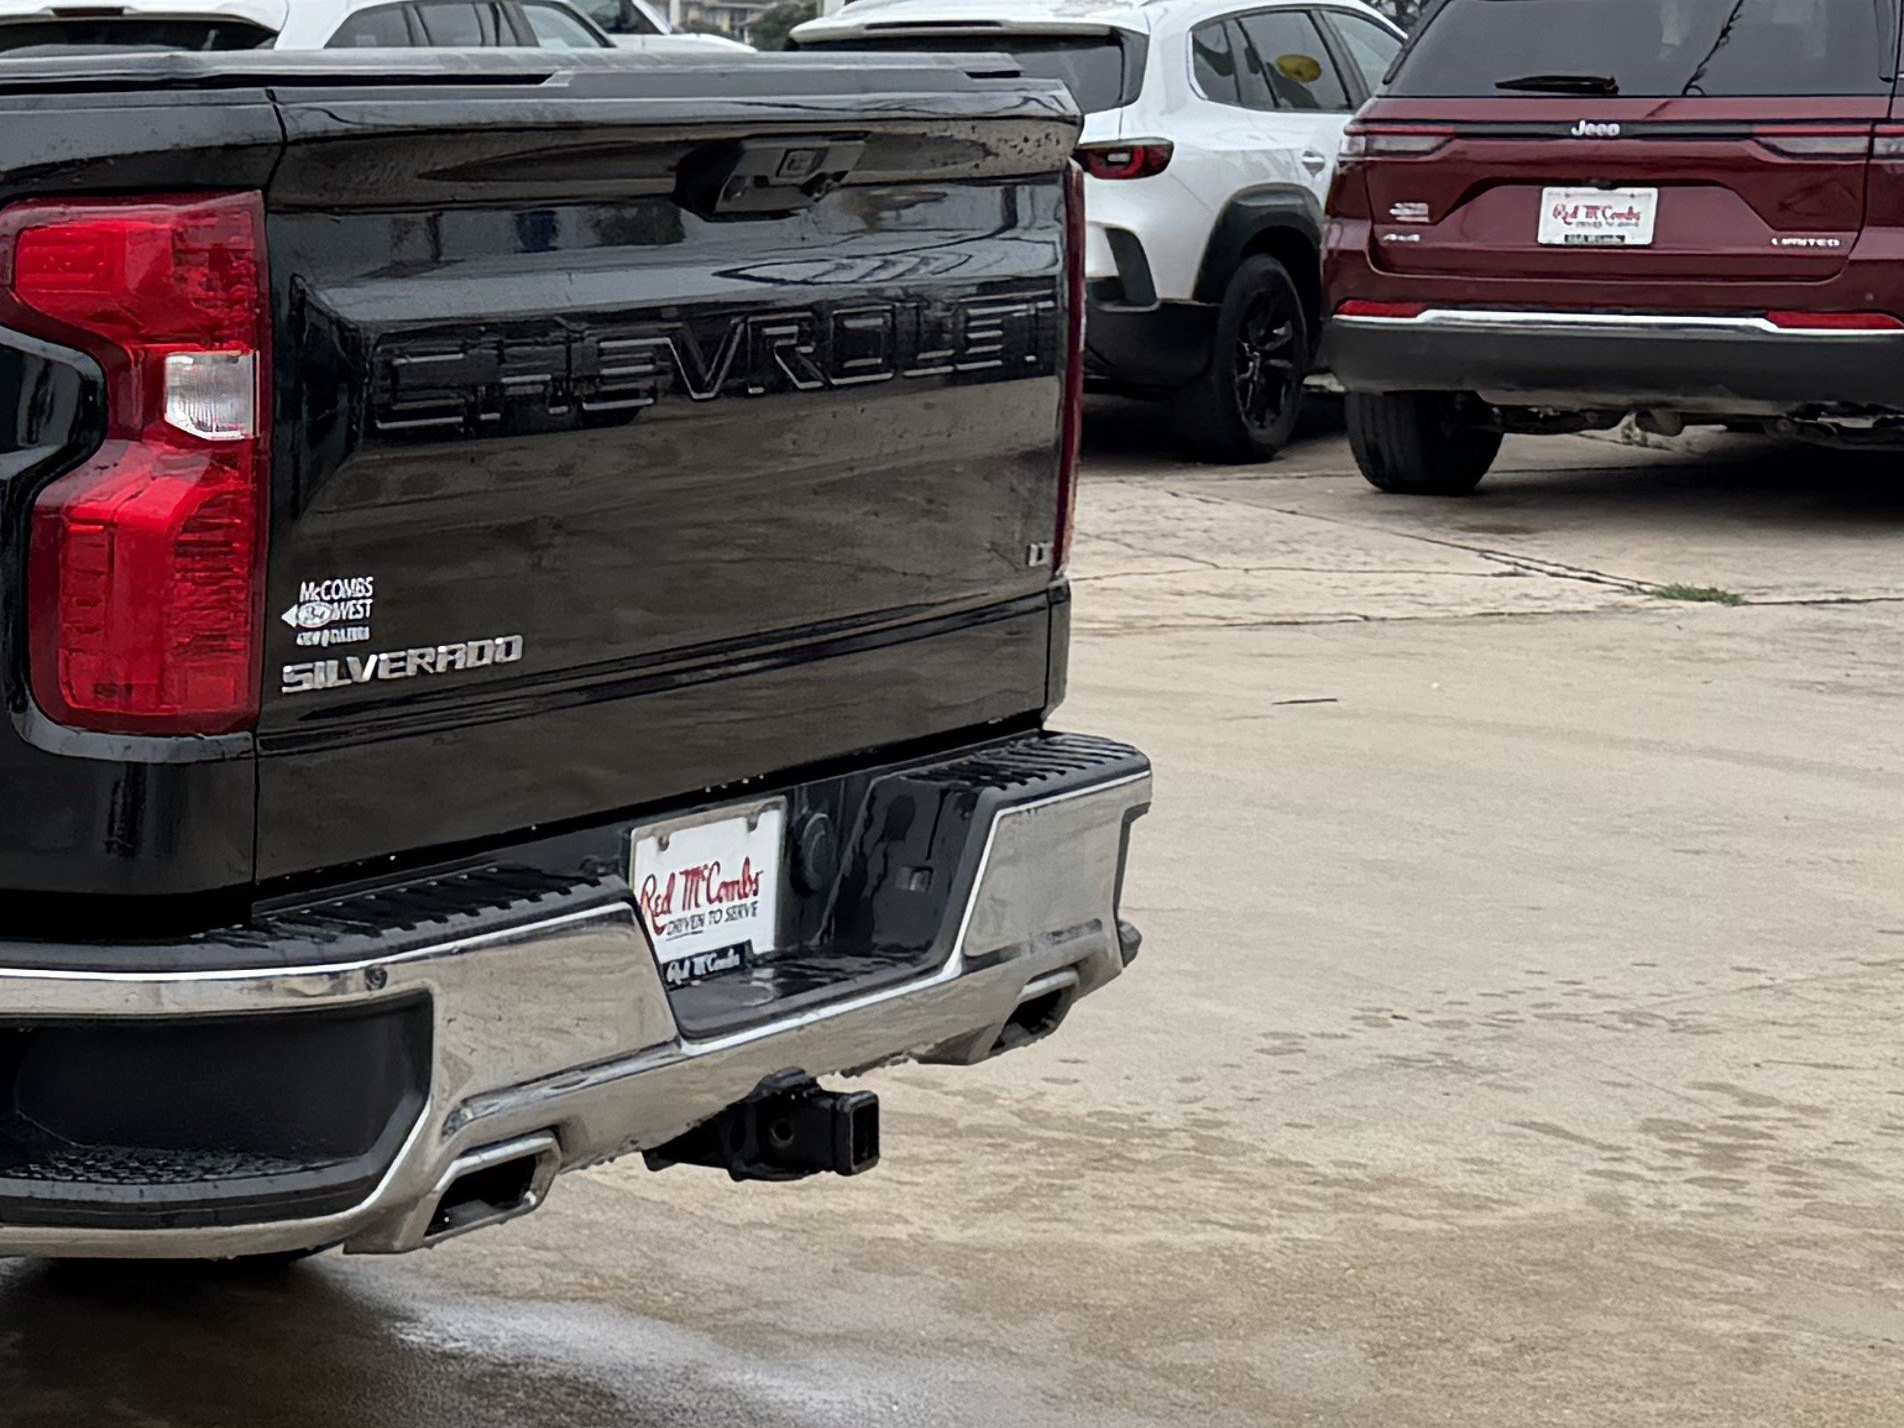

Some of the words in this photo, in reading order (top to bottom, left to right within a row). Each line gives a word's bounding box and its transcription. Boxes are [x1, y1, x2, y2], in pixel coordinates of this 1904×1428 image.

[1571, 120, 1620, 136] Jeep
[376, 298, 1055, 430] CHEVROLET
[332, 599, 373, 620] WEST
[282, 635, 523, 693] SILVERADO
[640, 872, 676, 935] Red
[667, 913, 706, 936] DRIVEN
[708, 909, 723, 926] TO
[726, 900, 759, 923] SERVE
